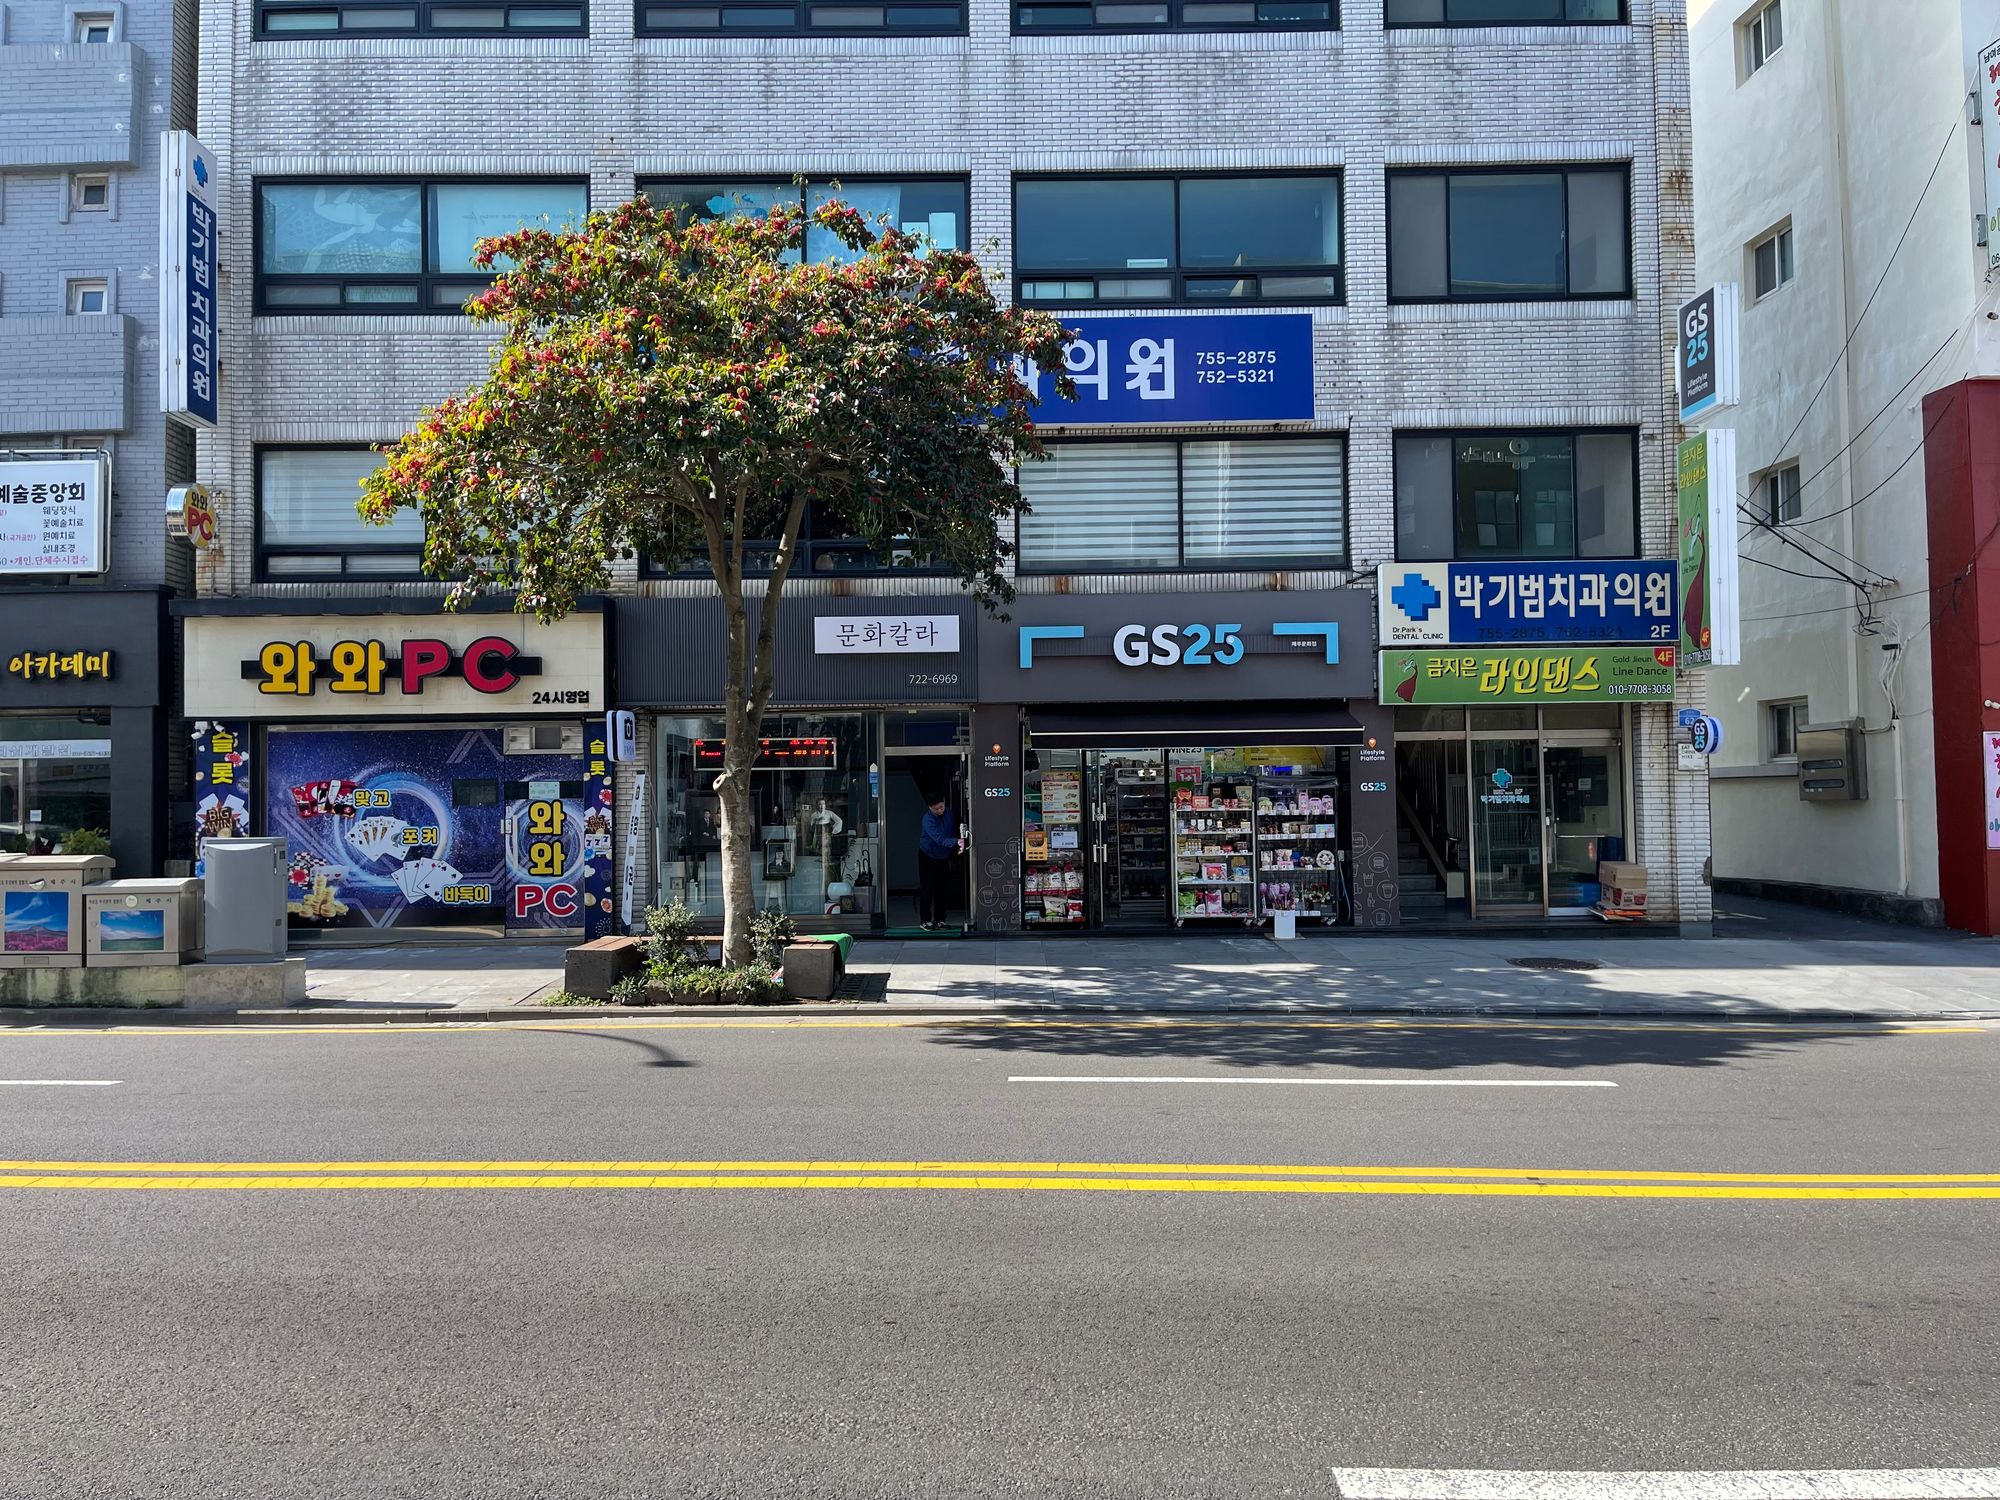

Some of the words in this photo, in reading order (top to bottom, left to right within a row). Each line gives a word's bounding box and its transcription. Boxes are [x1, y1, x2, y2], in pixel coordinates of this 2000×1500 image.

[192, 201, 211, 402] 박기범치과의원
[1685, 302, 1708, 338] GS
[1687, 329, 1708, 369] 25
[1196, 351, 1276, 365] 755-2875
[1196, 369, 1275, 384] 752-5321
[1687, 372, 1708, 389] Lifestyle
[1687, 381, 1708, 398] Platform
[1682, 442, 1704, 467] 금지은
[1679, 463, 1707, 489] 라인댄스
[191, 491, 208, 511] 와와
[43, 505, 76, 516] 웨딩장식
[43, 518, 84, 528] 꽃예술치료
[188, 506, 213, 541] PC
[43, 531, 76, 541] 원예치료
[43, 544, 76, 554] 실내조경
[1454, 572, 1671, 618] 박기범치과의원
[836, 620, 939, 648] 문화칼라
[1555, 626, 1623, 638] 752-5321
[1650, 625, 1670, 638] 2F
[1702, 630, 1710, 642] 4F
[1113, 623, 1245, 667] GS25
[1612, 655, 1630, 663] Gold
[1631, 655, 1653, 663] Jieun
[1657, 651, 1673, 663] 4F
[9, 651, 110, 680] 아카데미
[1426, 657, 1478, 678] 금지은
[1612, 667, 1635, 676] Line
[1636, 667, 1668, 676] Dance
[908, 673, 958, 685] 722-6969
[1479, 655, 1600, 696] 라인댄스
[532, 690, 590, 704] 24시영업
[1608, 684, 1672, 695] 010-7708-3058
[1694, 722, 1706, 735] GS
[1694, 735, 1706, 749] 25
[211, 731, 234, 785] 슬롯
[590, 739, 606, 776] 슬롯
[984, 788, 1011, 797] GS25
[1360, 782, 1387, 791] GS25
[354, 789, 390, 807] 맞고
[208, 807, 230, 821] BIG
[206, 819, 233, 833] WIN
[402, 827, 438, 845] 포커
[443, 885, 490, 903] 바둑이
[515, 884, 578, 918] PC
